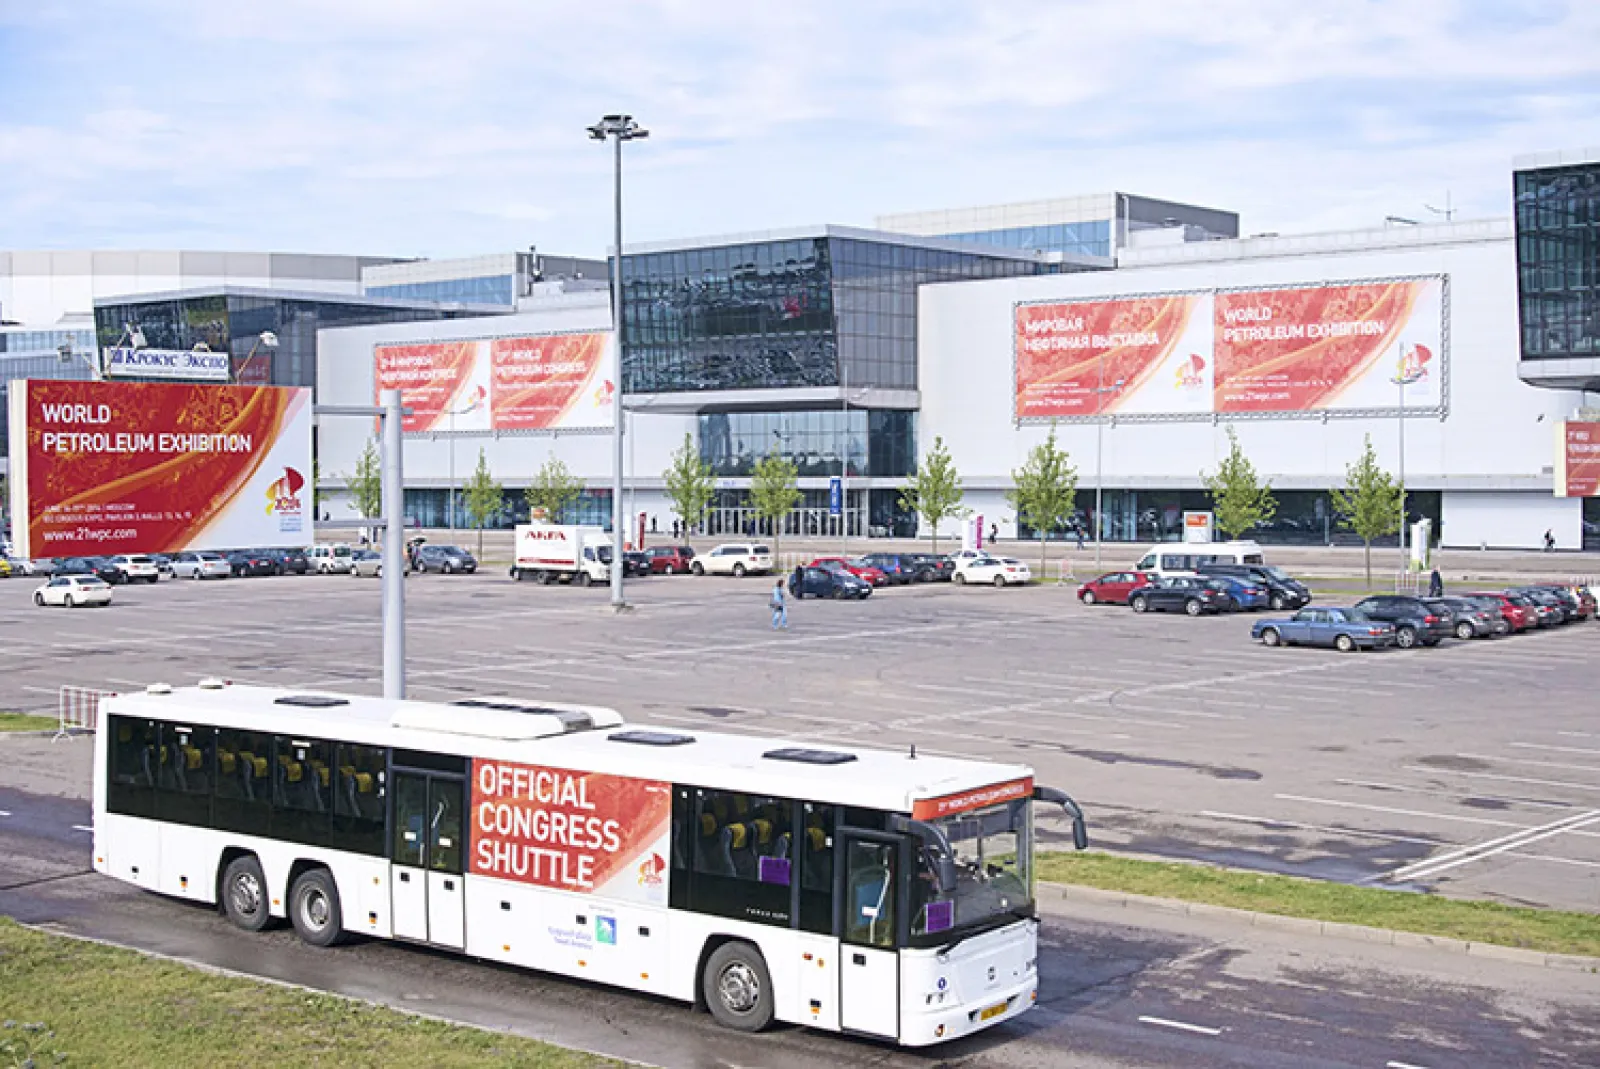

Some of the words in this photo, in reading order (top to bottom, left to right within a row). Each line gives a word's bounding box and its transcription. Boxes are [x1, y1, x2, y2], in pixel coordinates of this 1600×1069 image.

[1224, 307, 1272, 322] WORLD
[1025, 317, 1083, 333] МИРОВАЯ
[1224, 325, 1304, 342] PETROLEUM
[1307, 320, 1385, 338] EXHIBITION
[42, 404, 111, 424] WORLD
[42, 432, 155, 452] PETROLEUM
[159, 434, 252, 452] EXHIBITION
[42, 527, 138, 543] www.21wpc.com
[479, 763, 596, 810] OFFICIAL
[478, 802, 620, 852] CONGRESS
[477, 839, 595, 888] SHUTTLE
